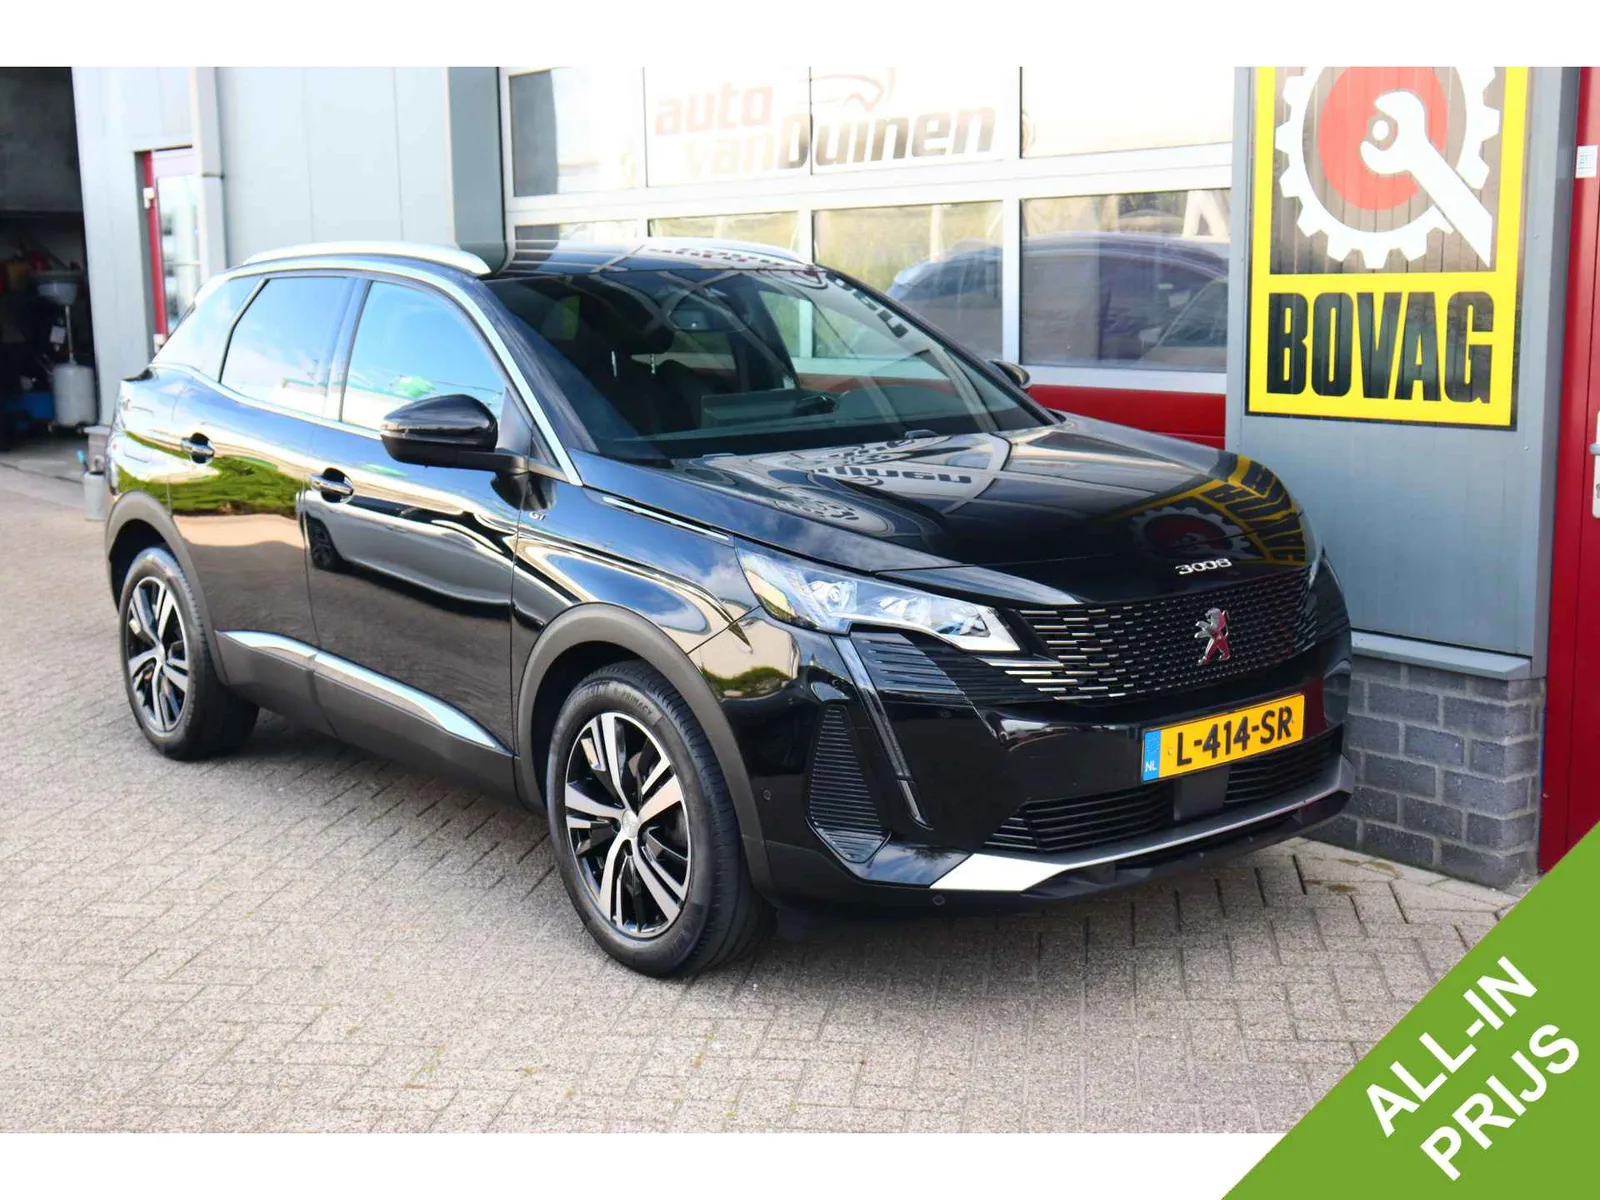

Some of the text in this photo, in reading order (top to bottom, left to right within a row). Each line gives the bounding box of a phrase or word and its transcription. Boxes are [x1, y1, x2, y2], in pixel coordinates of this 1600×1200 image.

[655, 82, 774, 137] auto
[1267, 291, 1494, 404] BOVAG
[1175, 558, 1232, 575] 3008
[1176, 705, 1293, 767] L-414-SR
[1145, 760, 1158, 773] NL
